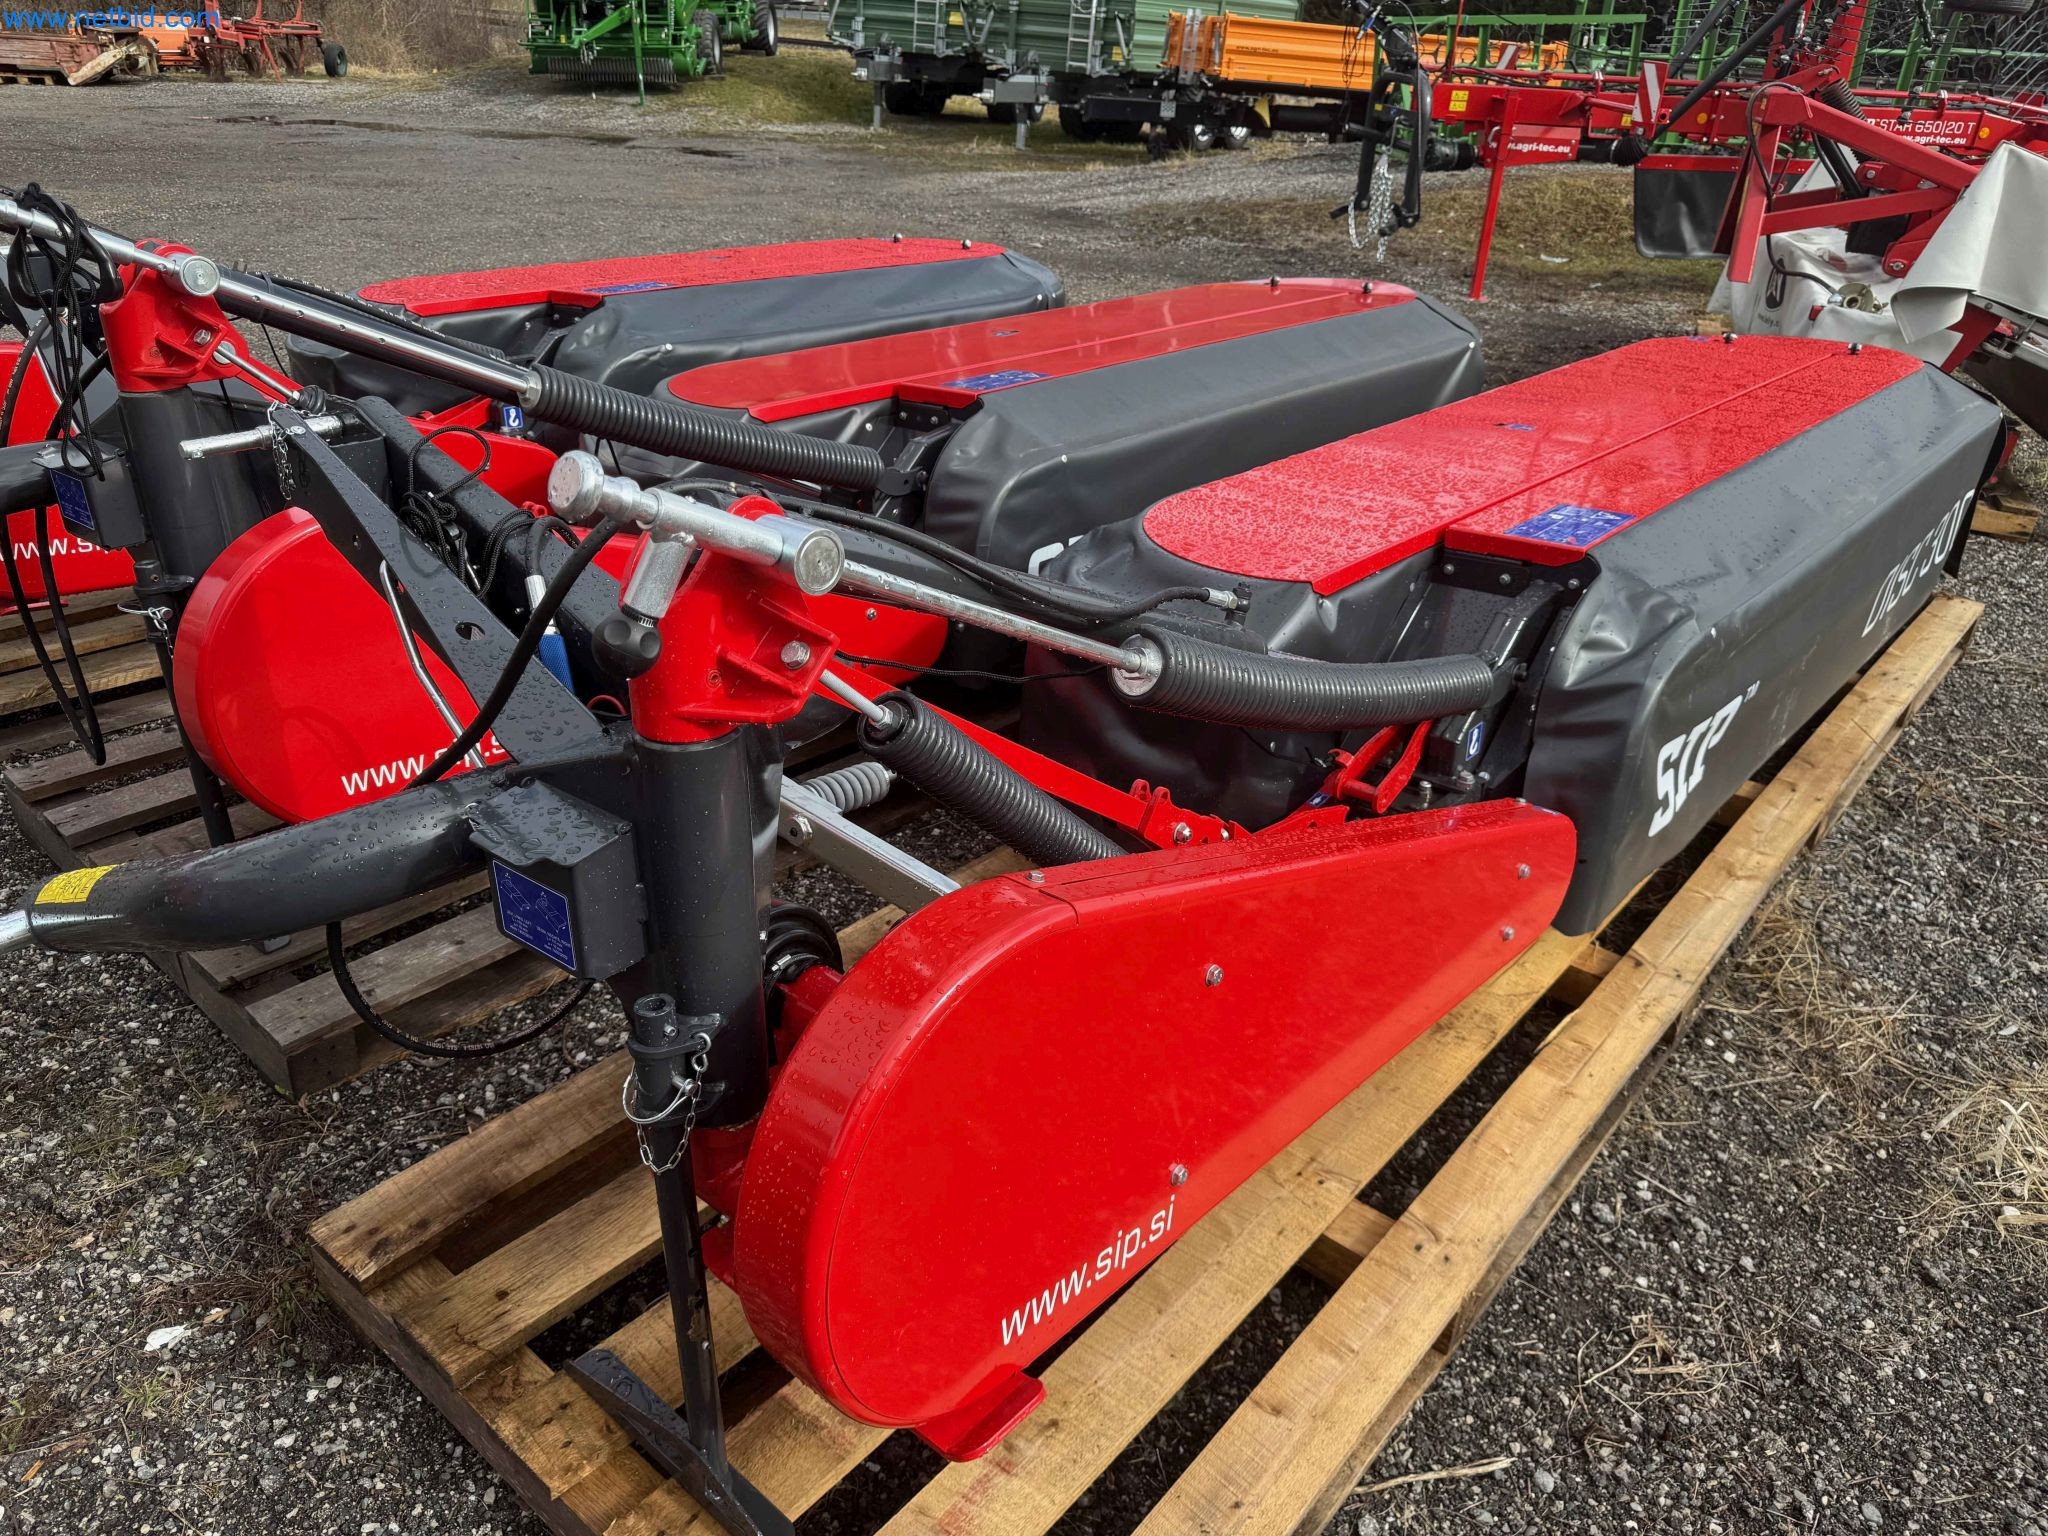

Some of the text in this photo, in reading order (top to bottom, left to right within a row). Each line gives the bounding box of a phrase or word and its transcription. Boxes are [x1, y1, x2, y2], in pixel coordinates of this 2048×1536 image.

[1967, 122, 1976, 134] T
[1648, 694, 1744, 838] SIP
[1001, 1193, 1176, 1346] www.sip.si
